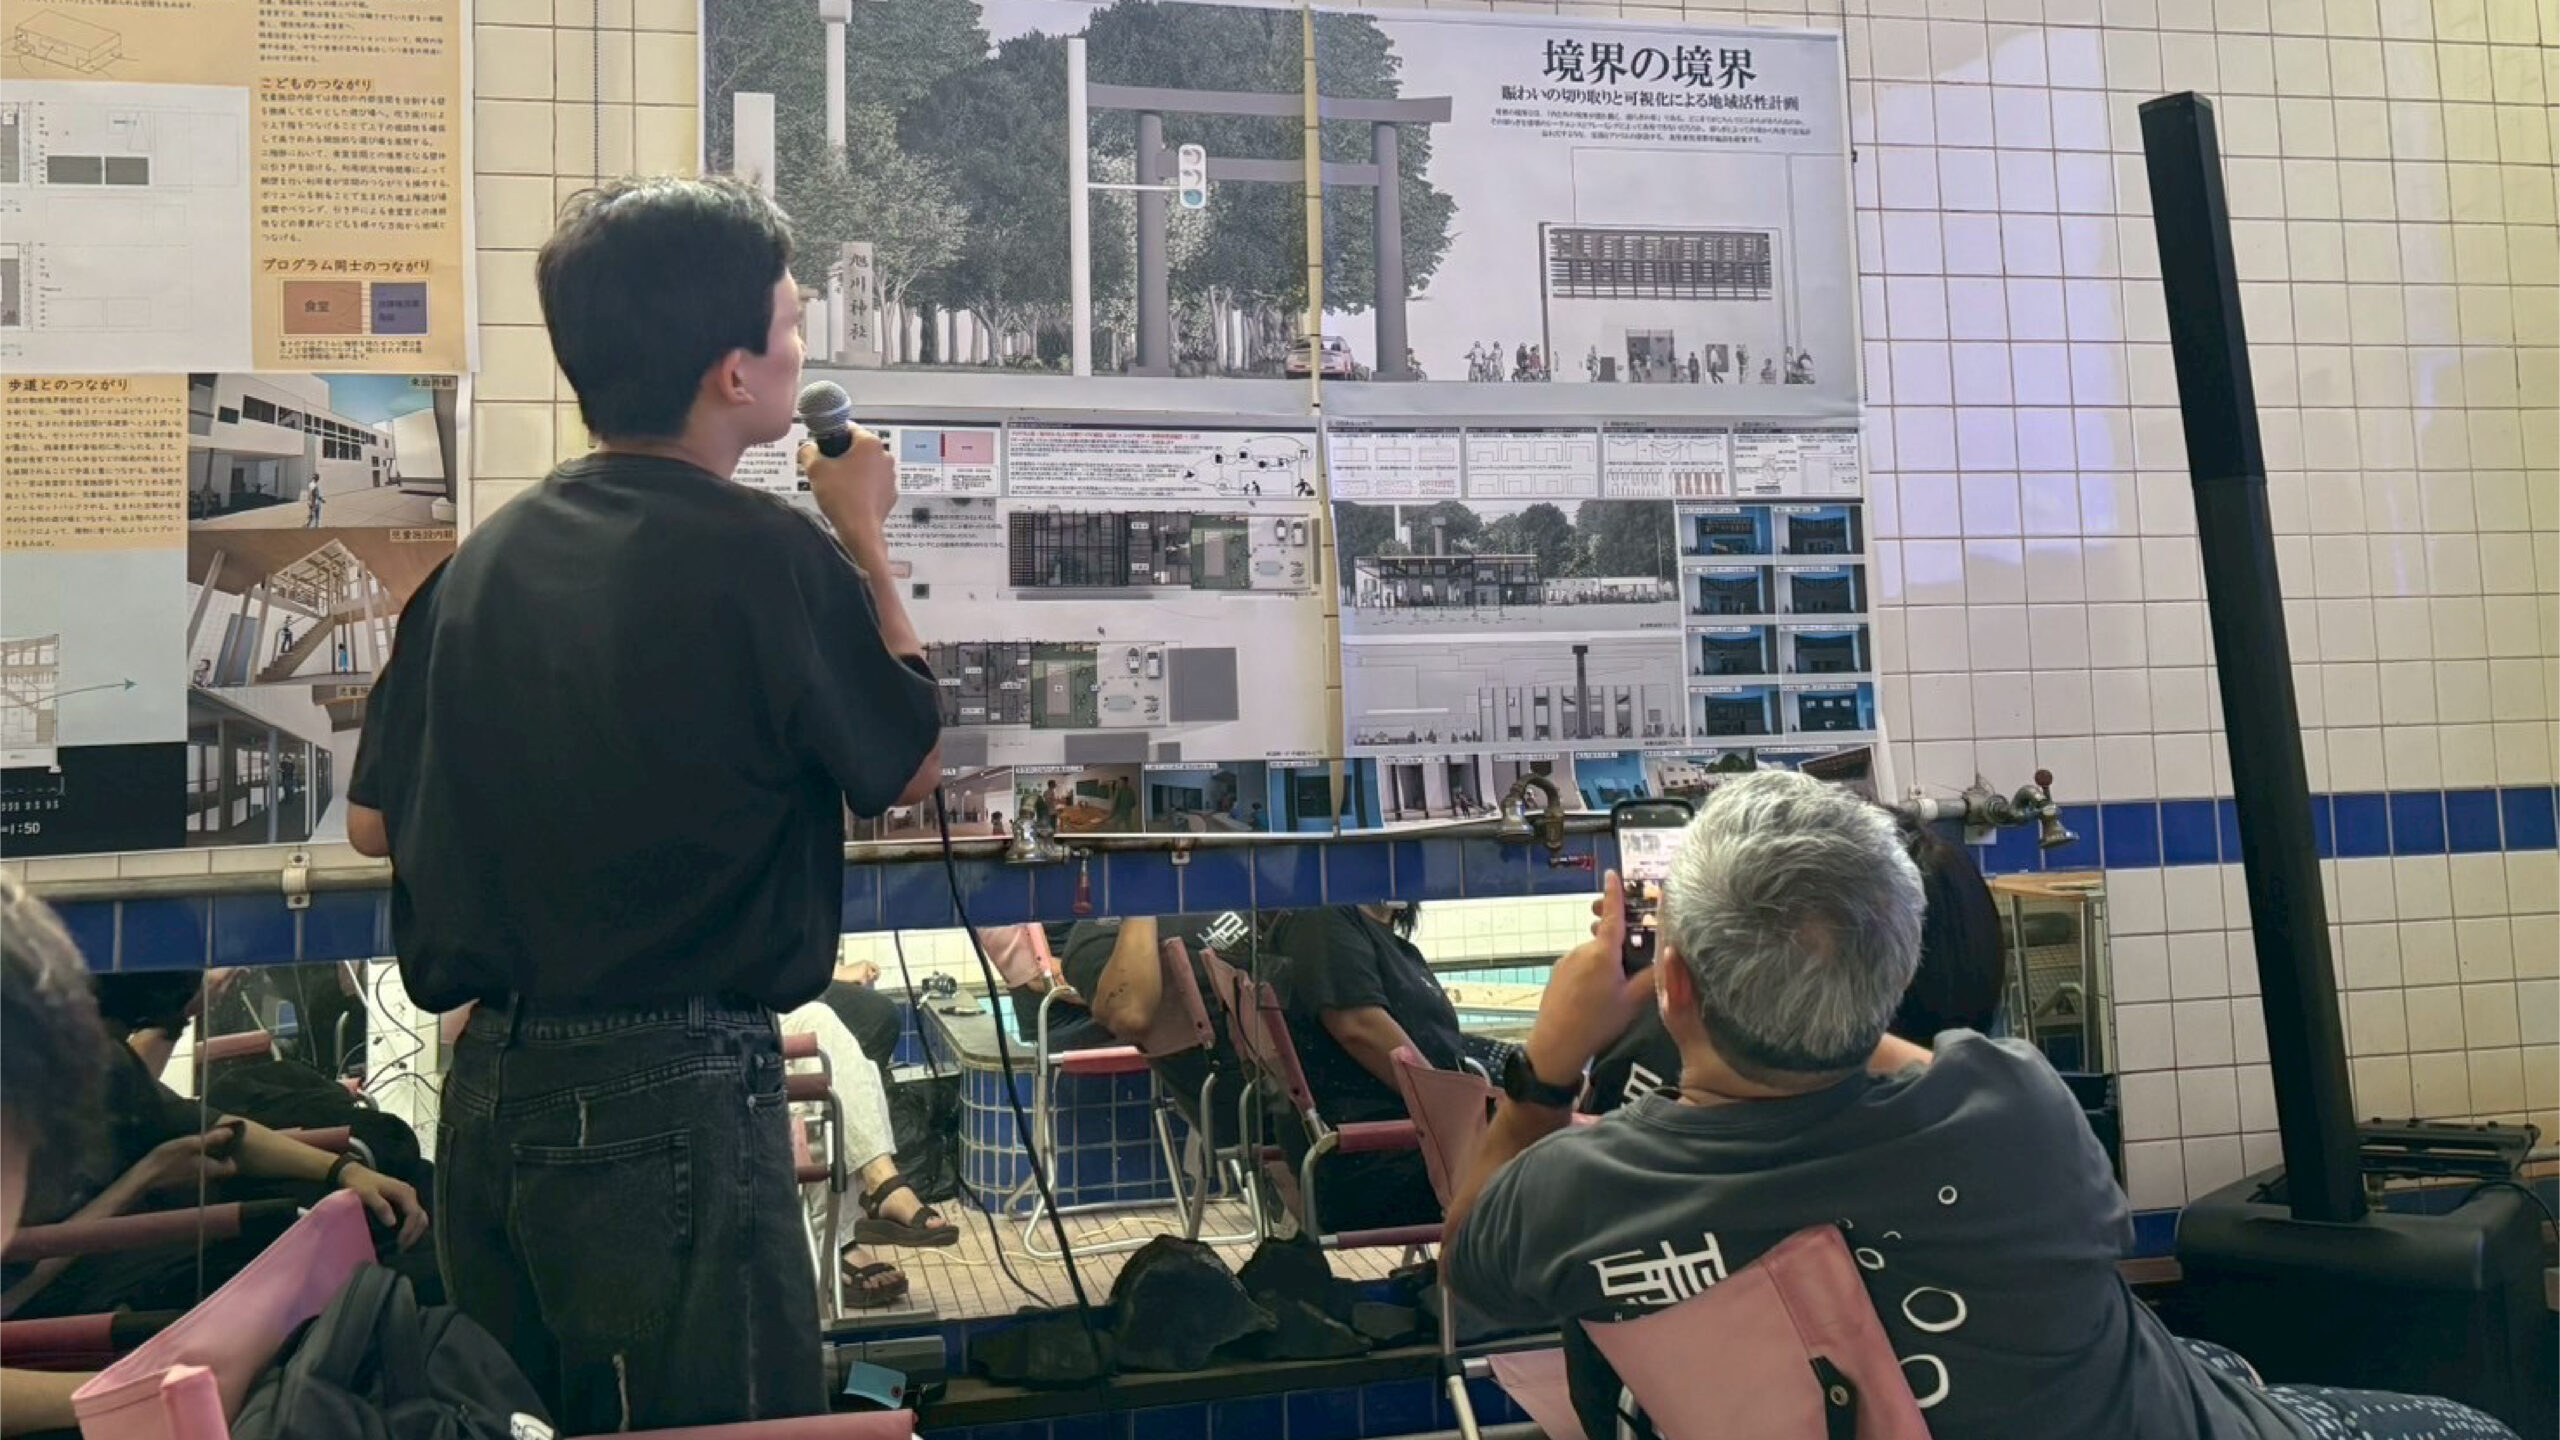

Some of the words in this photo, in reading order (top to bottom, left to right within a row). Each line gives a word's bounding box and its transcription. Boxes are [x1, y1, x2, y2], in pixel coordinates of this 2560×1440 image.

[1541, 38, 1757, 89] 境界の境界
[260, 77, 372, 91] こどものつながり
[1501, 85, 1800, 112] 賑わいの切り取りと可視化による地域活性計画
[263, 258, 431, 274] プログラム同士のつながり
[848, 253, 869, 341] 旭川神社
[304, 299, 331, 314] 食堂
[8, 378, 129, 393] 歩道とのつながり
